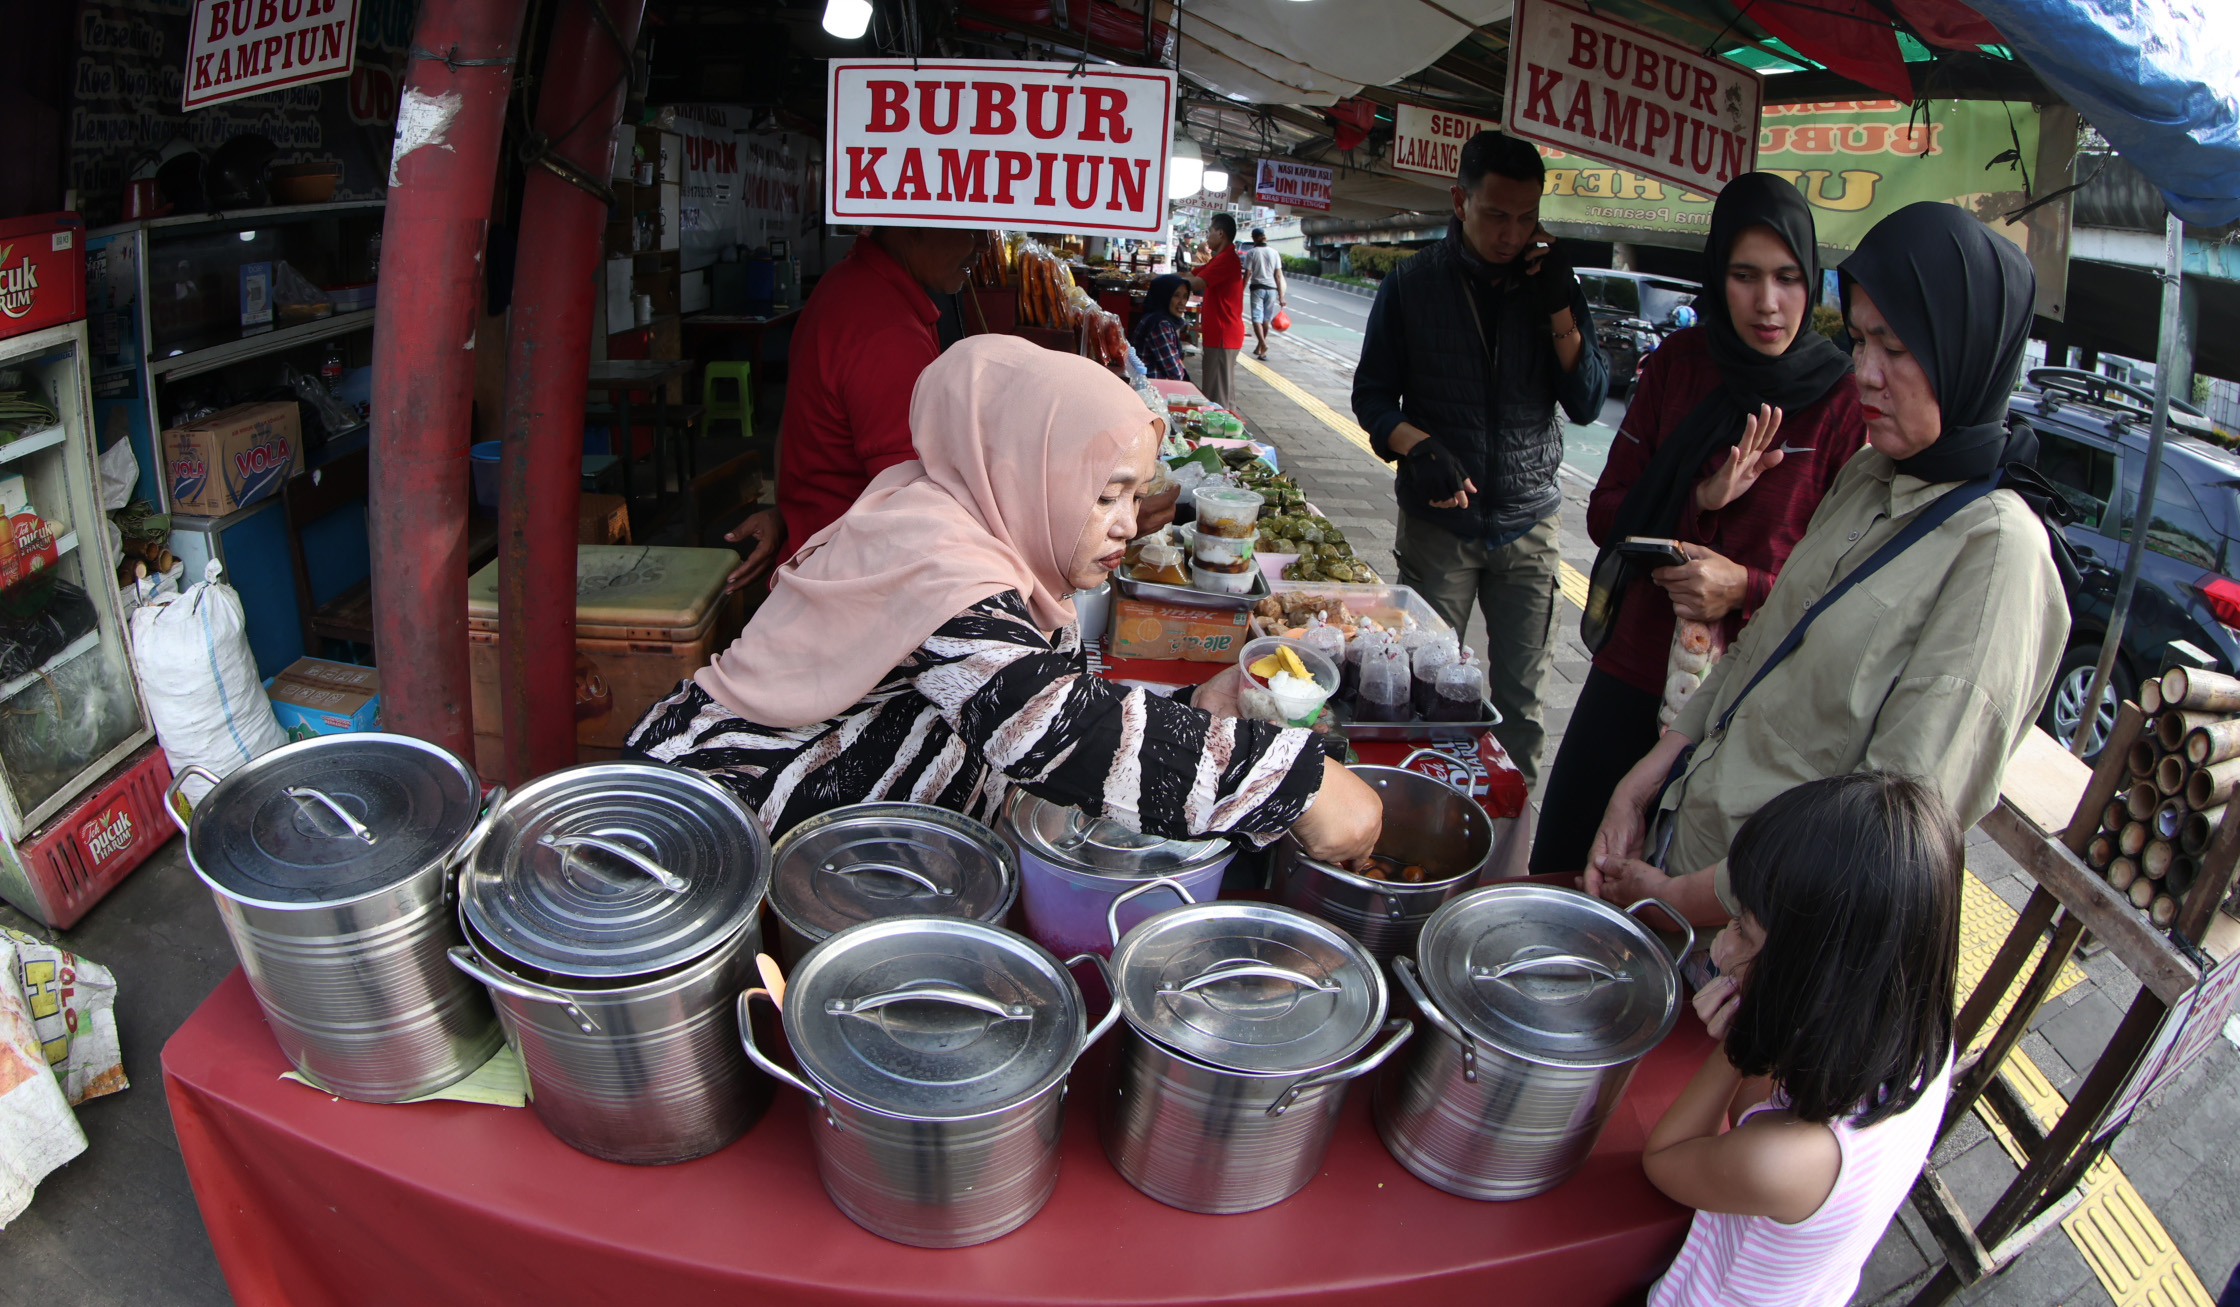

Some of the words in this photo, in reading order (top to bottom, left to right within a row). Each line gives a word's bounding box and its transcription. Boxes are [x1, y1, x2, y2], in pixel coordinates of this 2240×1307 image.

[193, 20, 345, 91] KAMPIUN
[1567, 22, 1718, 117] BUBUR
[79, 63, 111, 93] Kue
[865, 80, 1133, 144] BUBUR
[1522, 62, 1747, 184] KAMPIUN
[686, 134, 738, 174] UPIK
[1278, 164, 1294, 175] NASI
[1295, 166, 1317, 178] KAPAU
[1318, 169, 1333, 181] ASLI
[1397, 135, 1459, 174] LAMANG
[845, 147, 1151, 213] KAMPIUN
[1207, 191, 1227, 200] POP
[1275, 176, 1298, 195] UNI
[1301, 180, 1333, 200] UPIK
[1180, 198, 1198, 206] SOP
[1201, 200, 1223, 210] SAPI
[170, 460, 207, 479] VOLA
[235, 438, 291, 480] VOLA
[99, 829, 132, 860] HARUM
